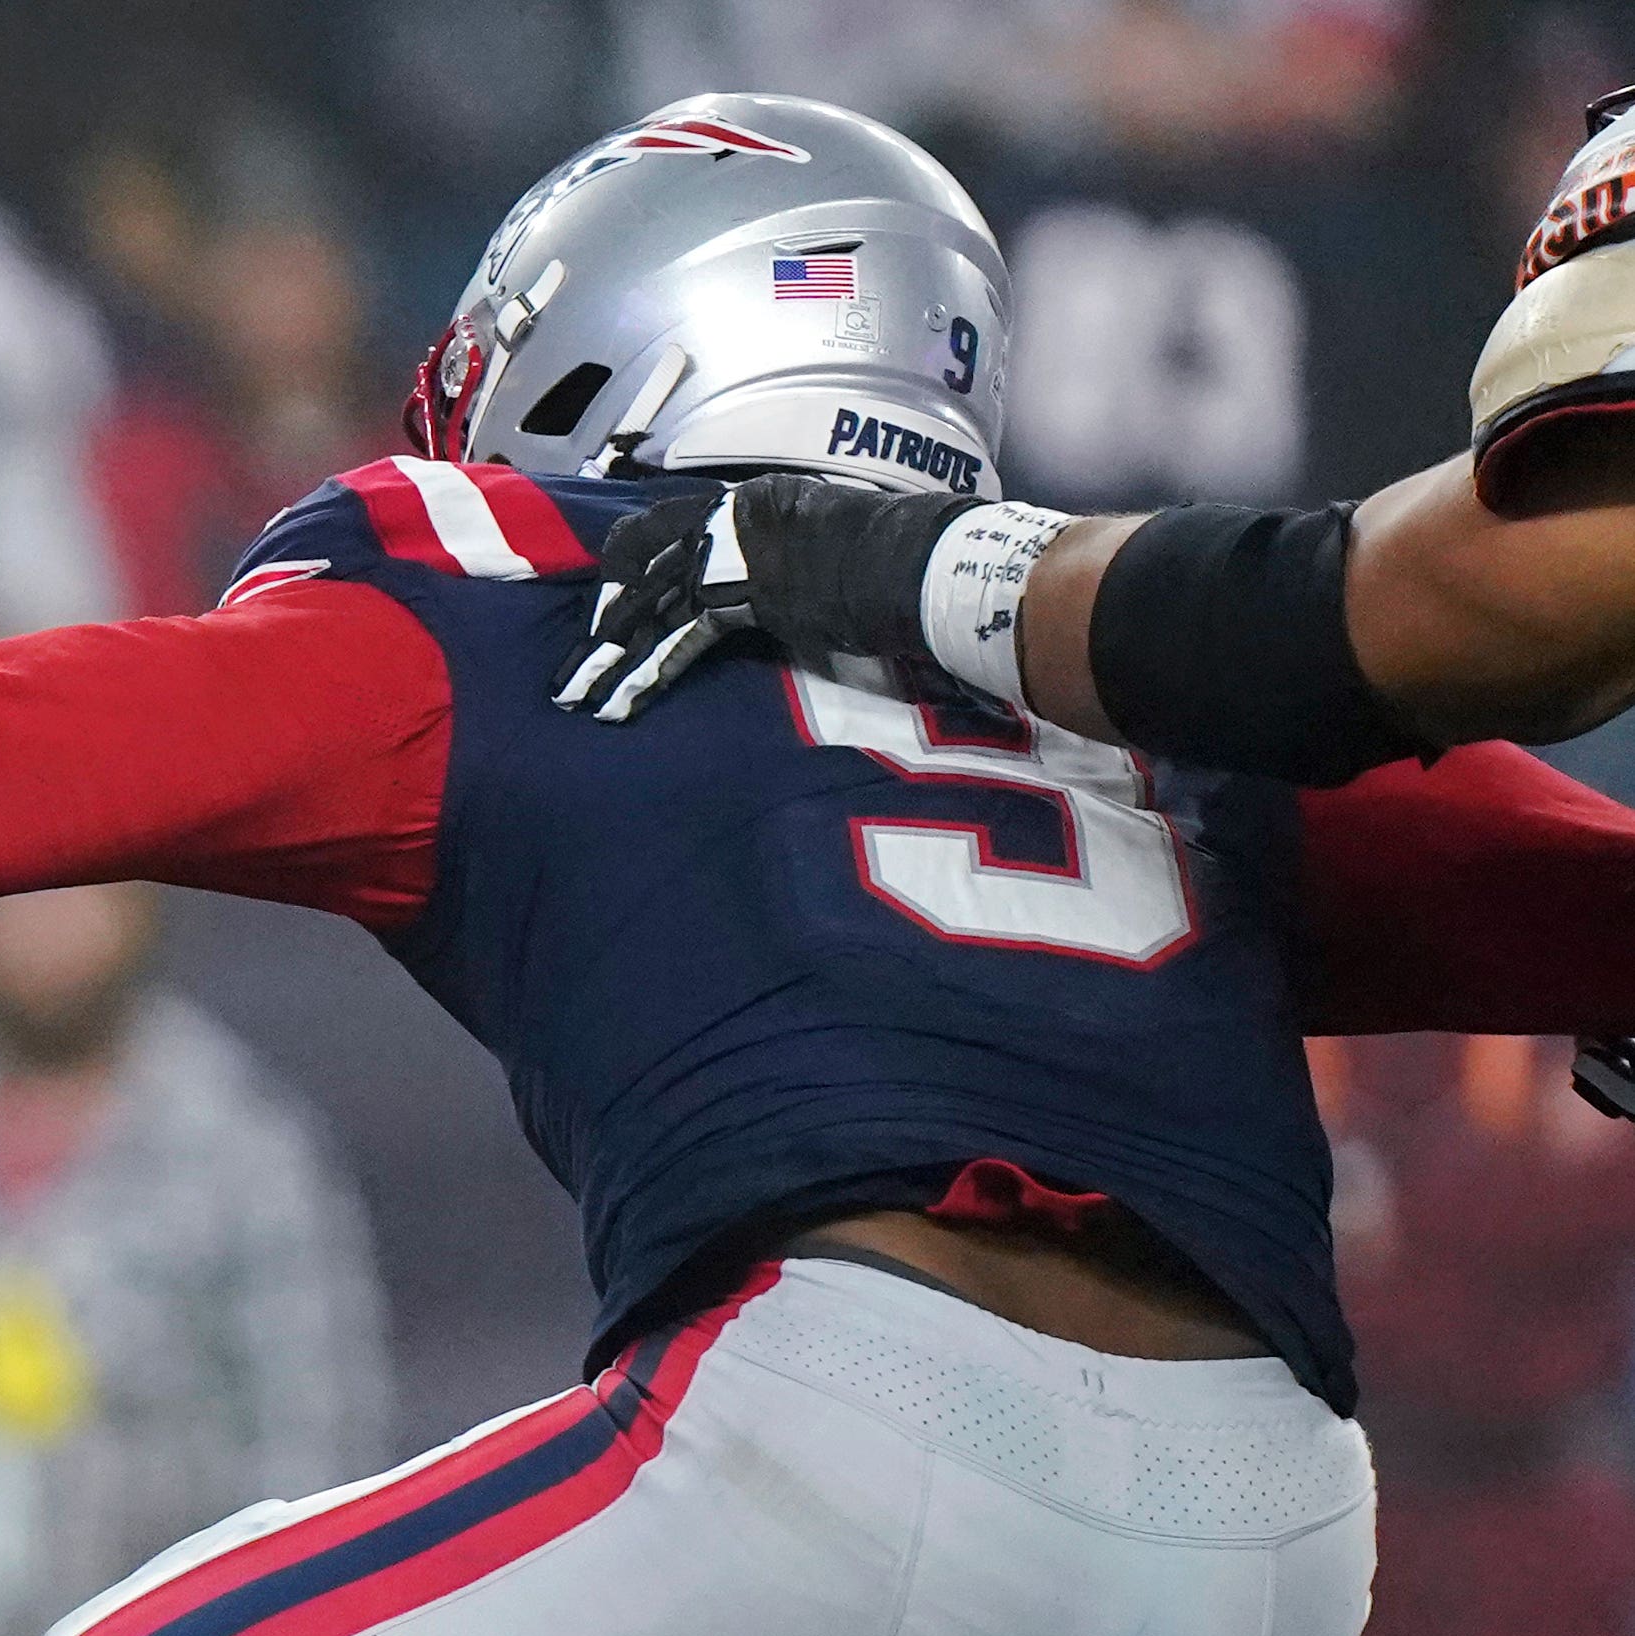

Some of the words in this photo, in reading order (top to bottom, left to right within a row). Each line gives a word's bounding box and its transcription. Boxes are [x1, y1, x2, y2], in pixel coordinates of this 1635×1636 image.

[943, 316, 979, 395] 9
[827, 408, 983, 495] PATRIOTS
[781, 667, 1200, 971] 9
